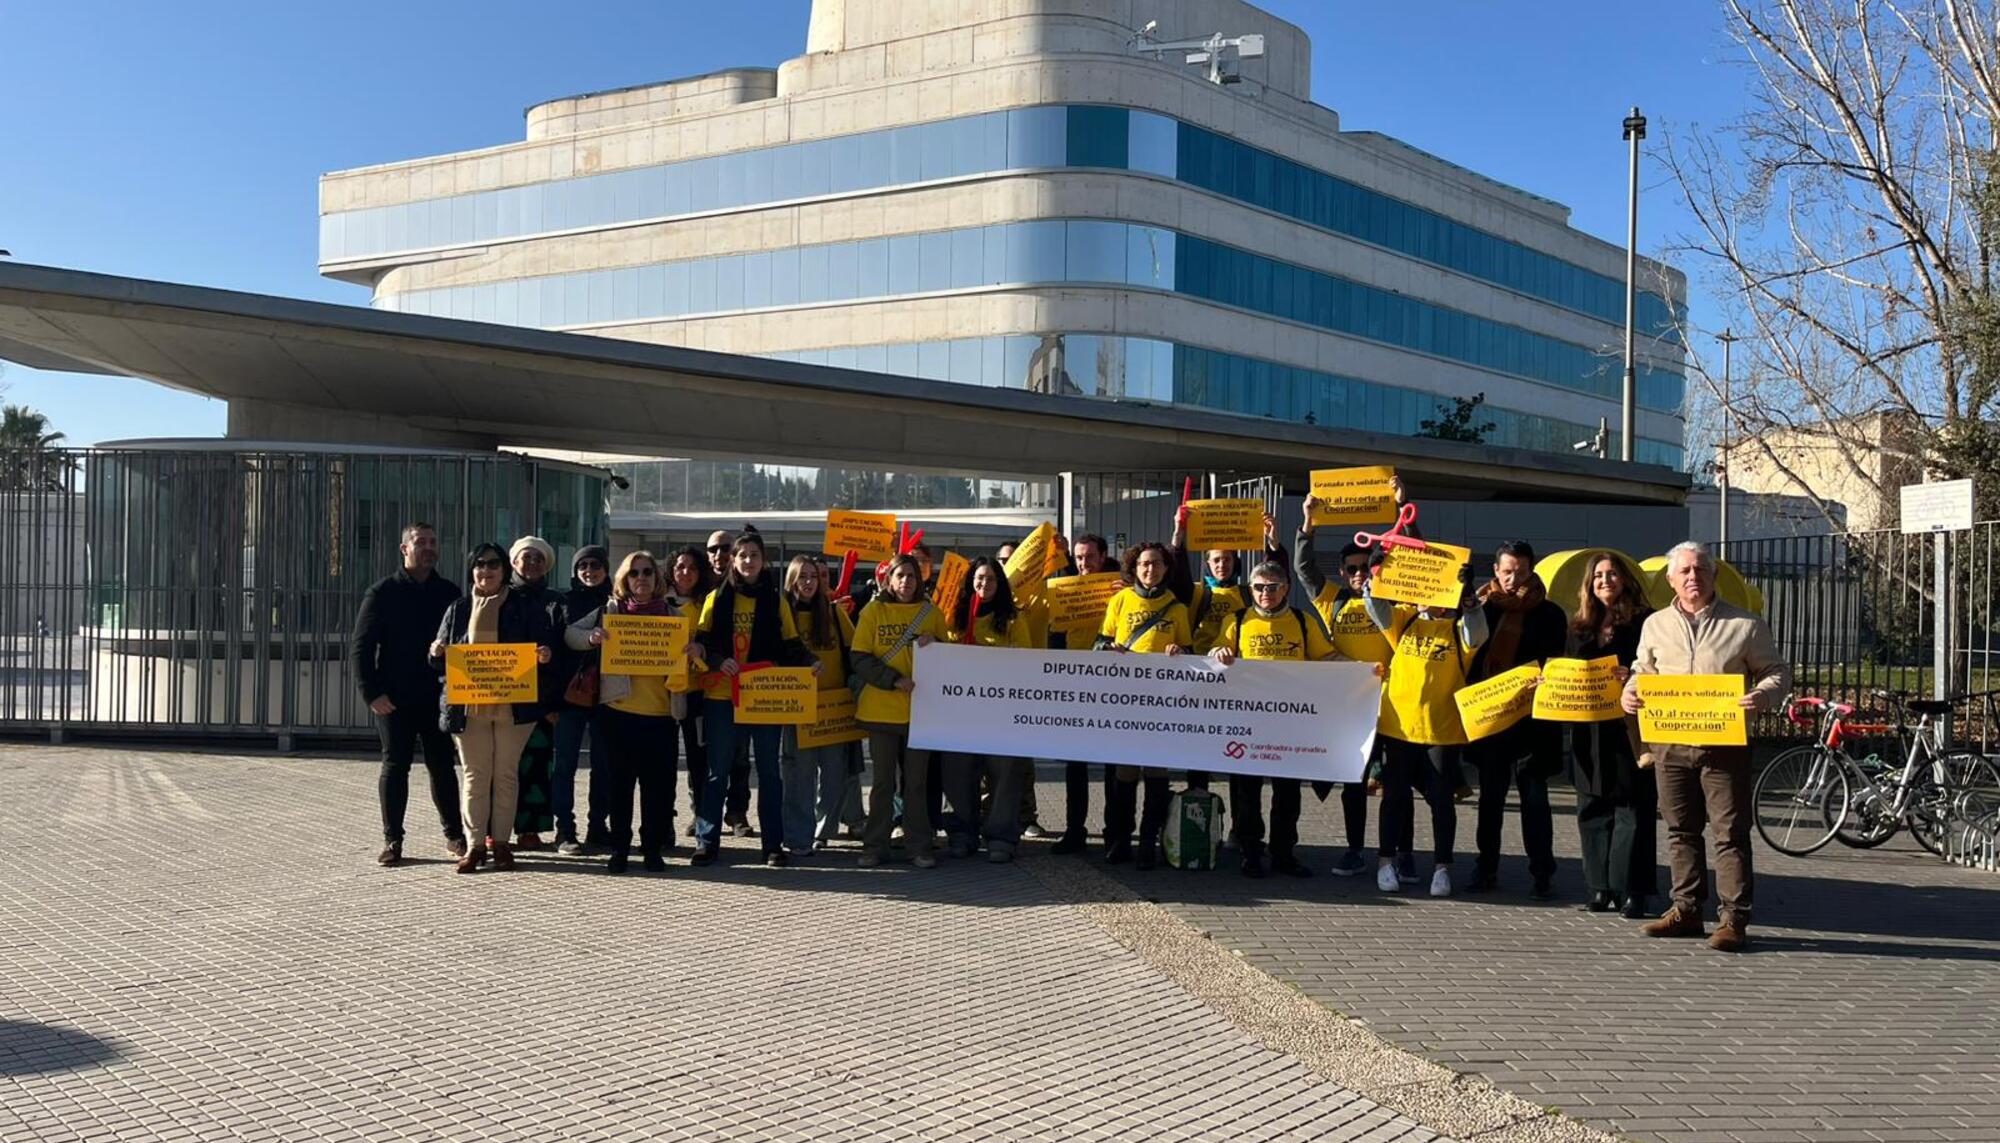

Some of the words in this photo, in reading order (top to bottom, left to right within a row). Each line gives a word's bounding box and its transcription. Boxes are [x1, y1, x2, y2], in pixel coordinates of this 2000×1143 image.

[1314, 480, 1344, 488] Granada
[1398, 572, 1430, 582] Granada
[1249, 633, 1284, 647] STOP
[1043, 662, 1130, 678] DIPUTACIÓN
[1134, 667, 1152, 678] DE
[1156, 671, 1226, 684] GRANADA
[1642, 689, 1679, 697] Granada
[942, 685, 964, 696] NO
[967, 688, 976, 697] A
[980, 687, 1005, 699] LOS
[1008, 688, 1075, 702] RECORTES
[1079, 692, 1097, 703] EN
[1100, 693, 1199, 709] COOPERACIÓN
[1203, 699, 1318, 715] INTERNACIONAL
[1645, 709, 1663, 719] ¡NO
[1667, 709, 1676, 719] al
[1680, 710, 1720, 719] recorte
[1013, 714, 1085, 728] SOLUCIONES
[1087, 718, 1095, 728] A
[1097, 719, 1112, 729] LA
[1115, 720, 1205, 734] CONVOCATORIA
[1208, 725, 1222, 735] DE
[1226, 726, 1252, 736] 2024
